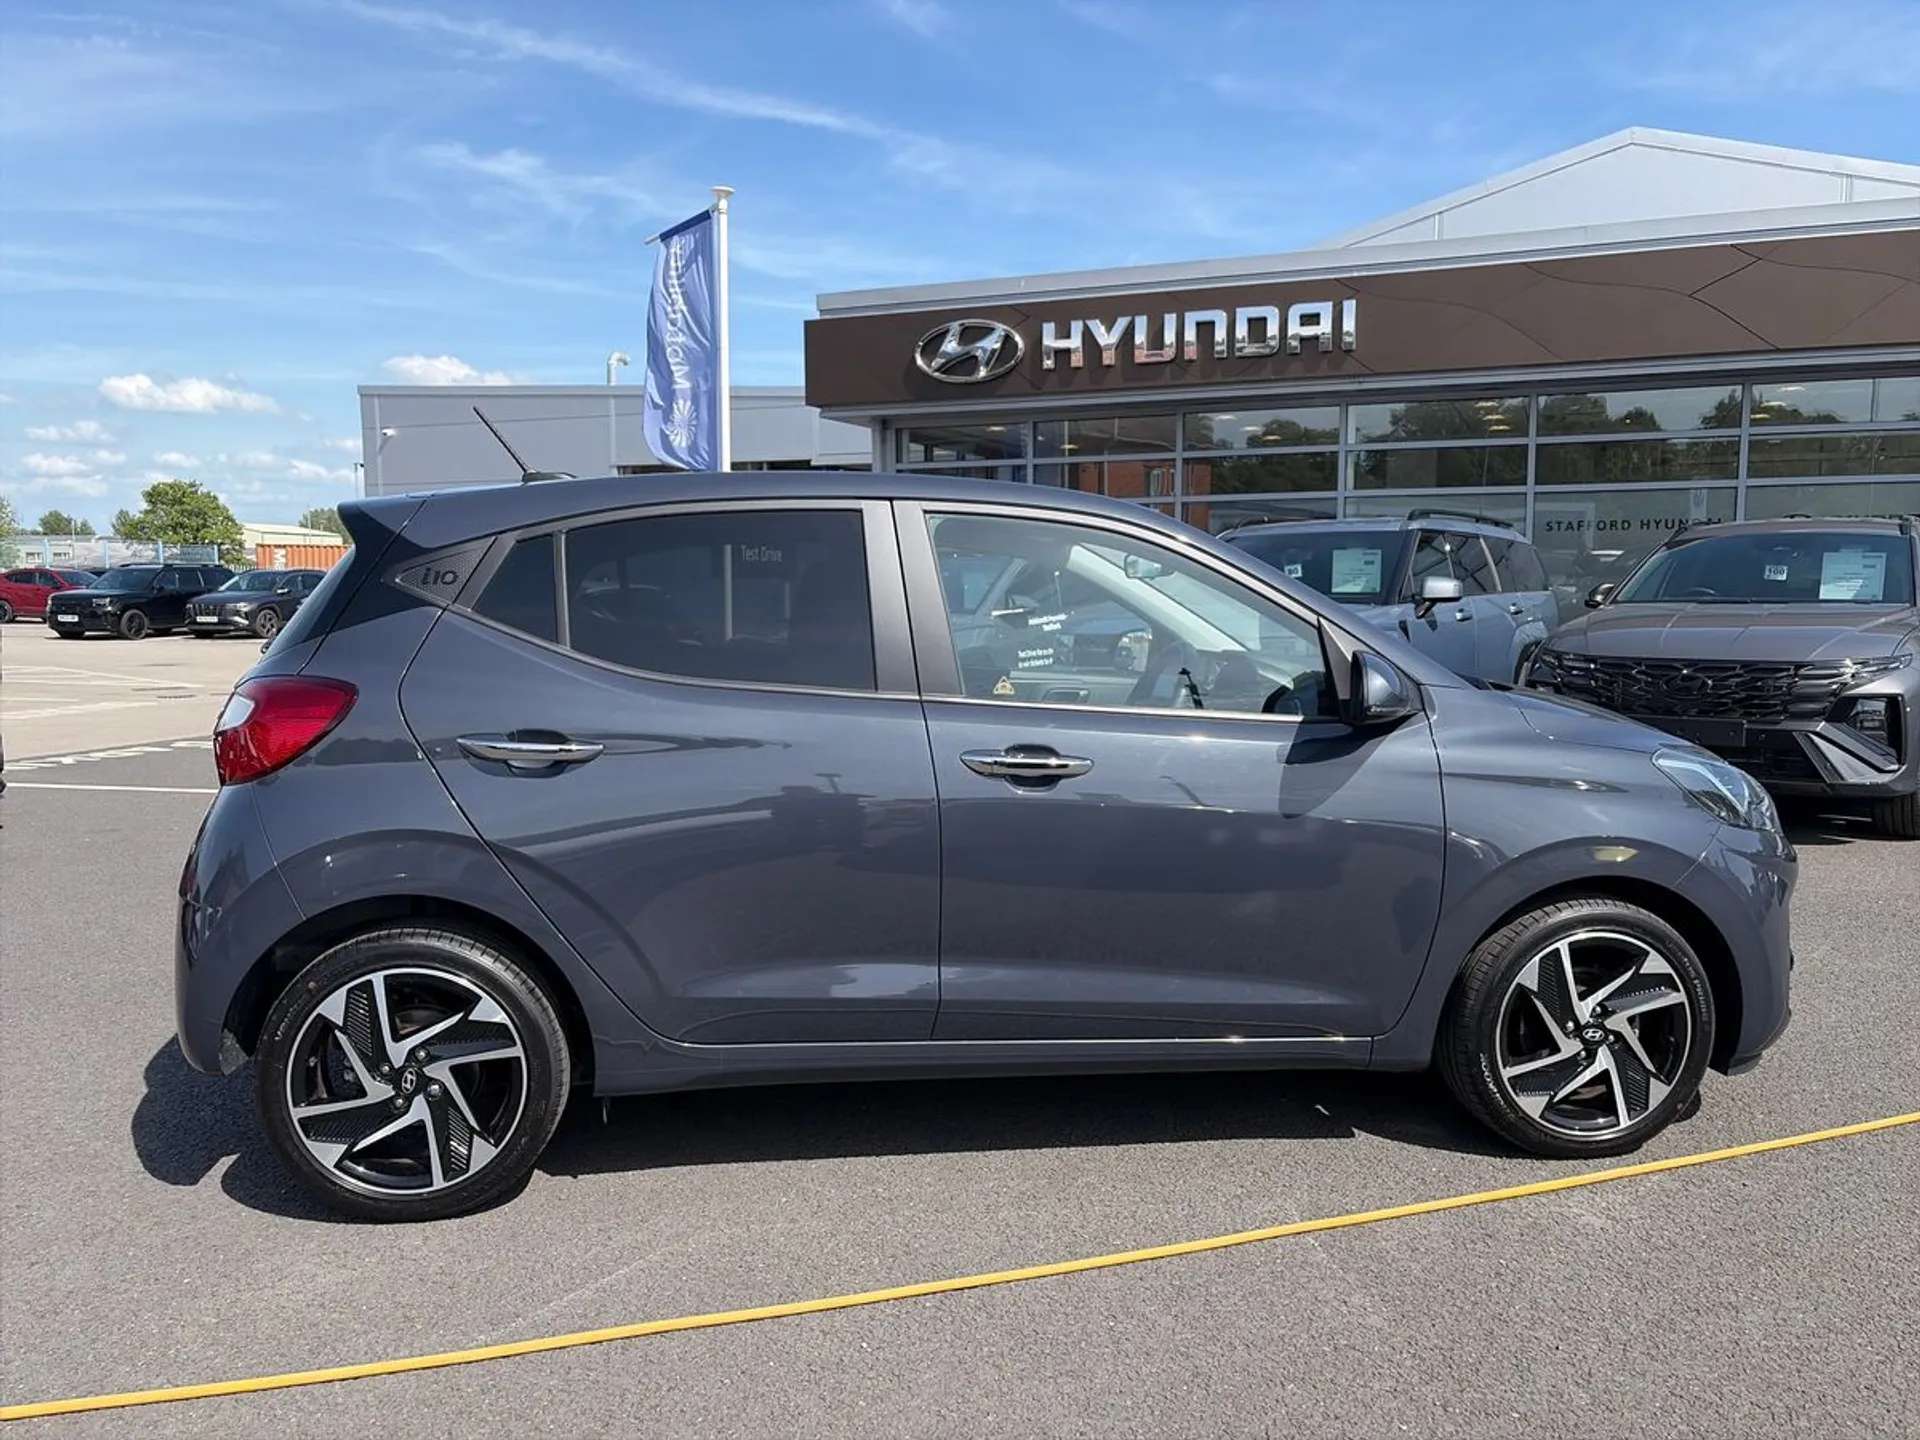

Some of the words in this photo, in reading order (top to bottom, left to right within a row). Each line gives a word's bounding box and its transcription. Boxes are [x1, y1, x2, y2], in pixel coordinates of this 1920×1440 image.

[1041, 299, 1357, 370] HYUNDAI
[1545, 519, 1631, 532] STAFFORD
[741, 545, 760, 561] Test
[422, 567, 458, 585] i10
